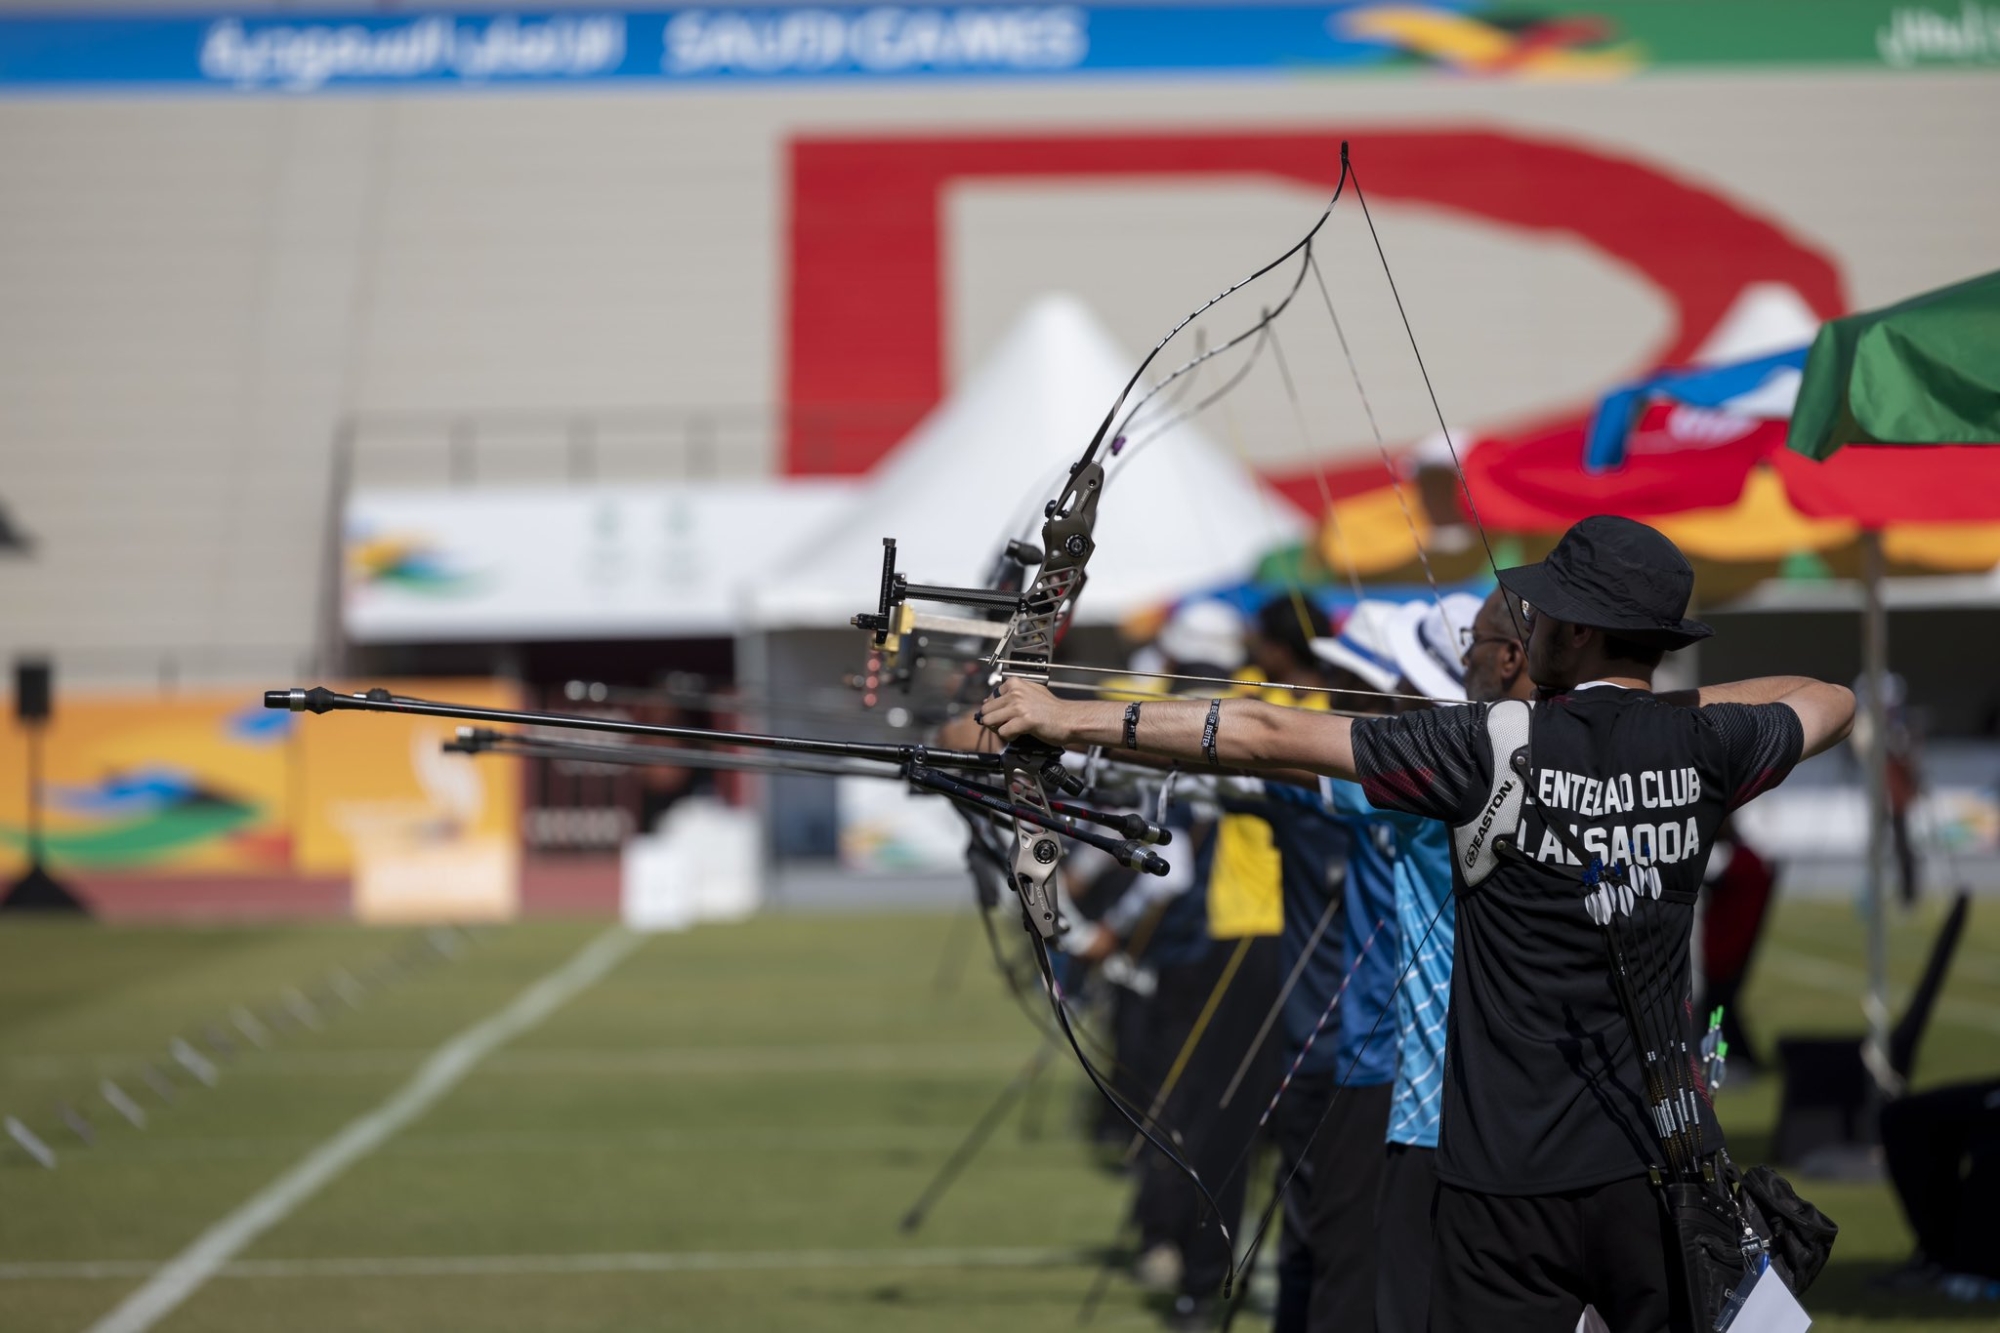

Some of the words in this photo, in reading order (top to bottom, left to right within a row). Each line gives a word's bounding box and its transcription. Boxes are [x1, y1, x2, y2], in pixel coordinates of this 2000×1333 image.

[661, 9, 847, 73] SAUDI
[852, 7, 1087, 71] GAMES
[1473, 780, 1514, 850] EASTON
[1640, 766, 1701, 809] CLUB
